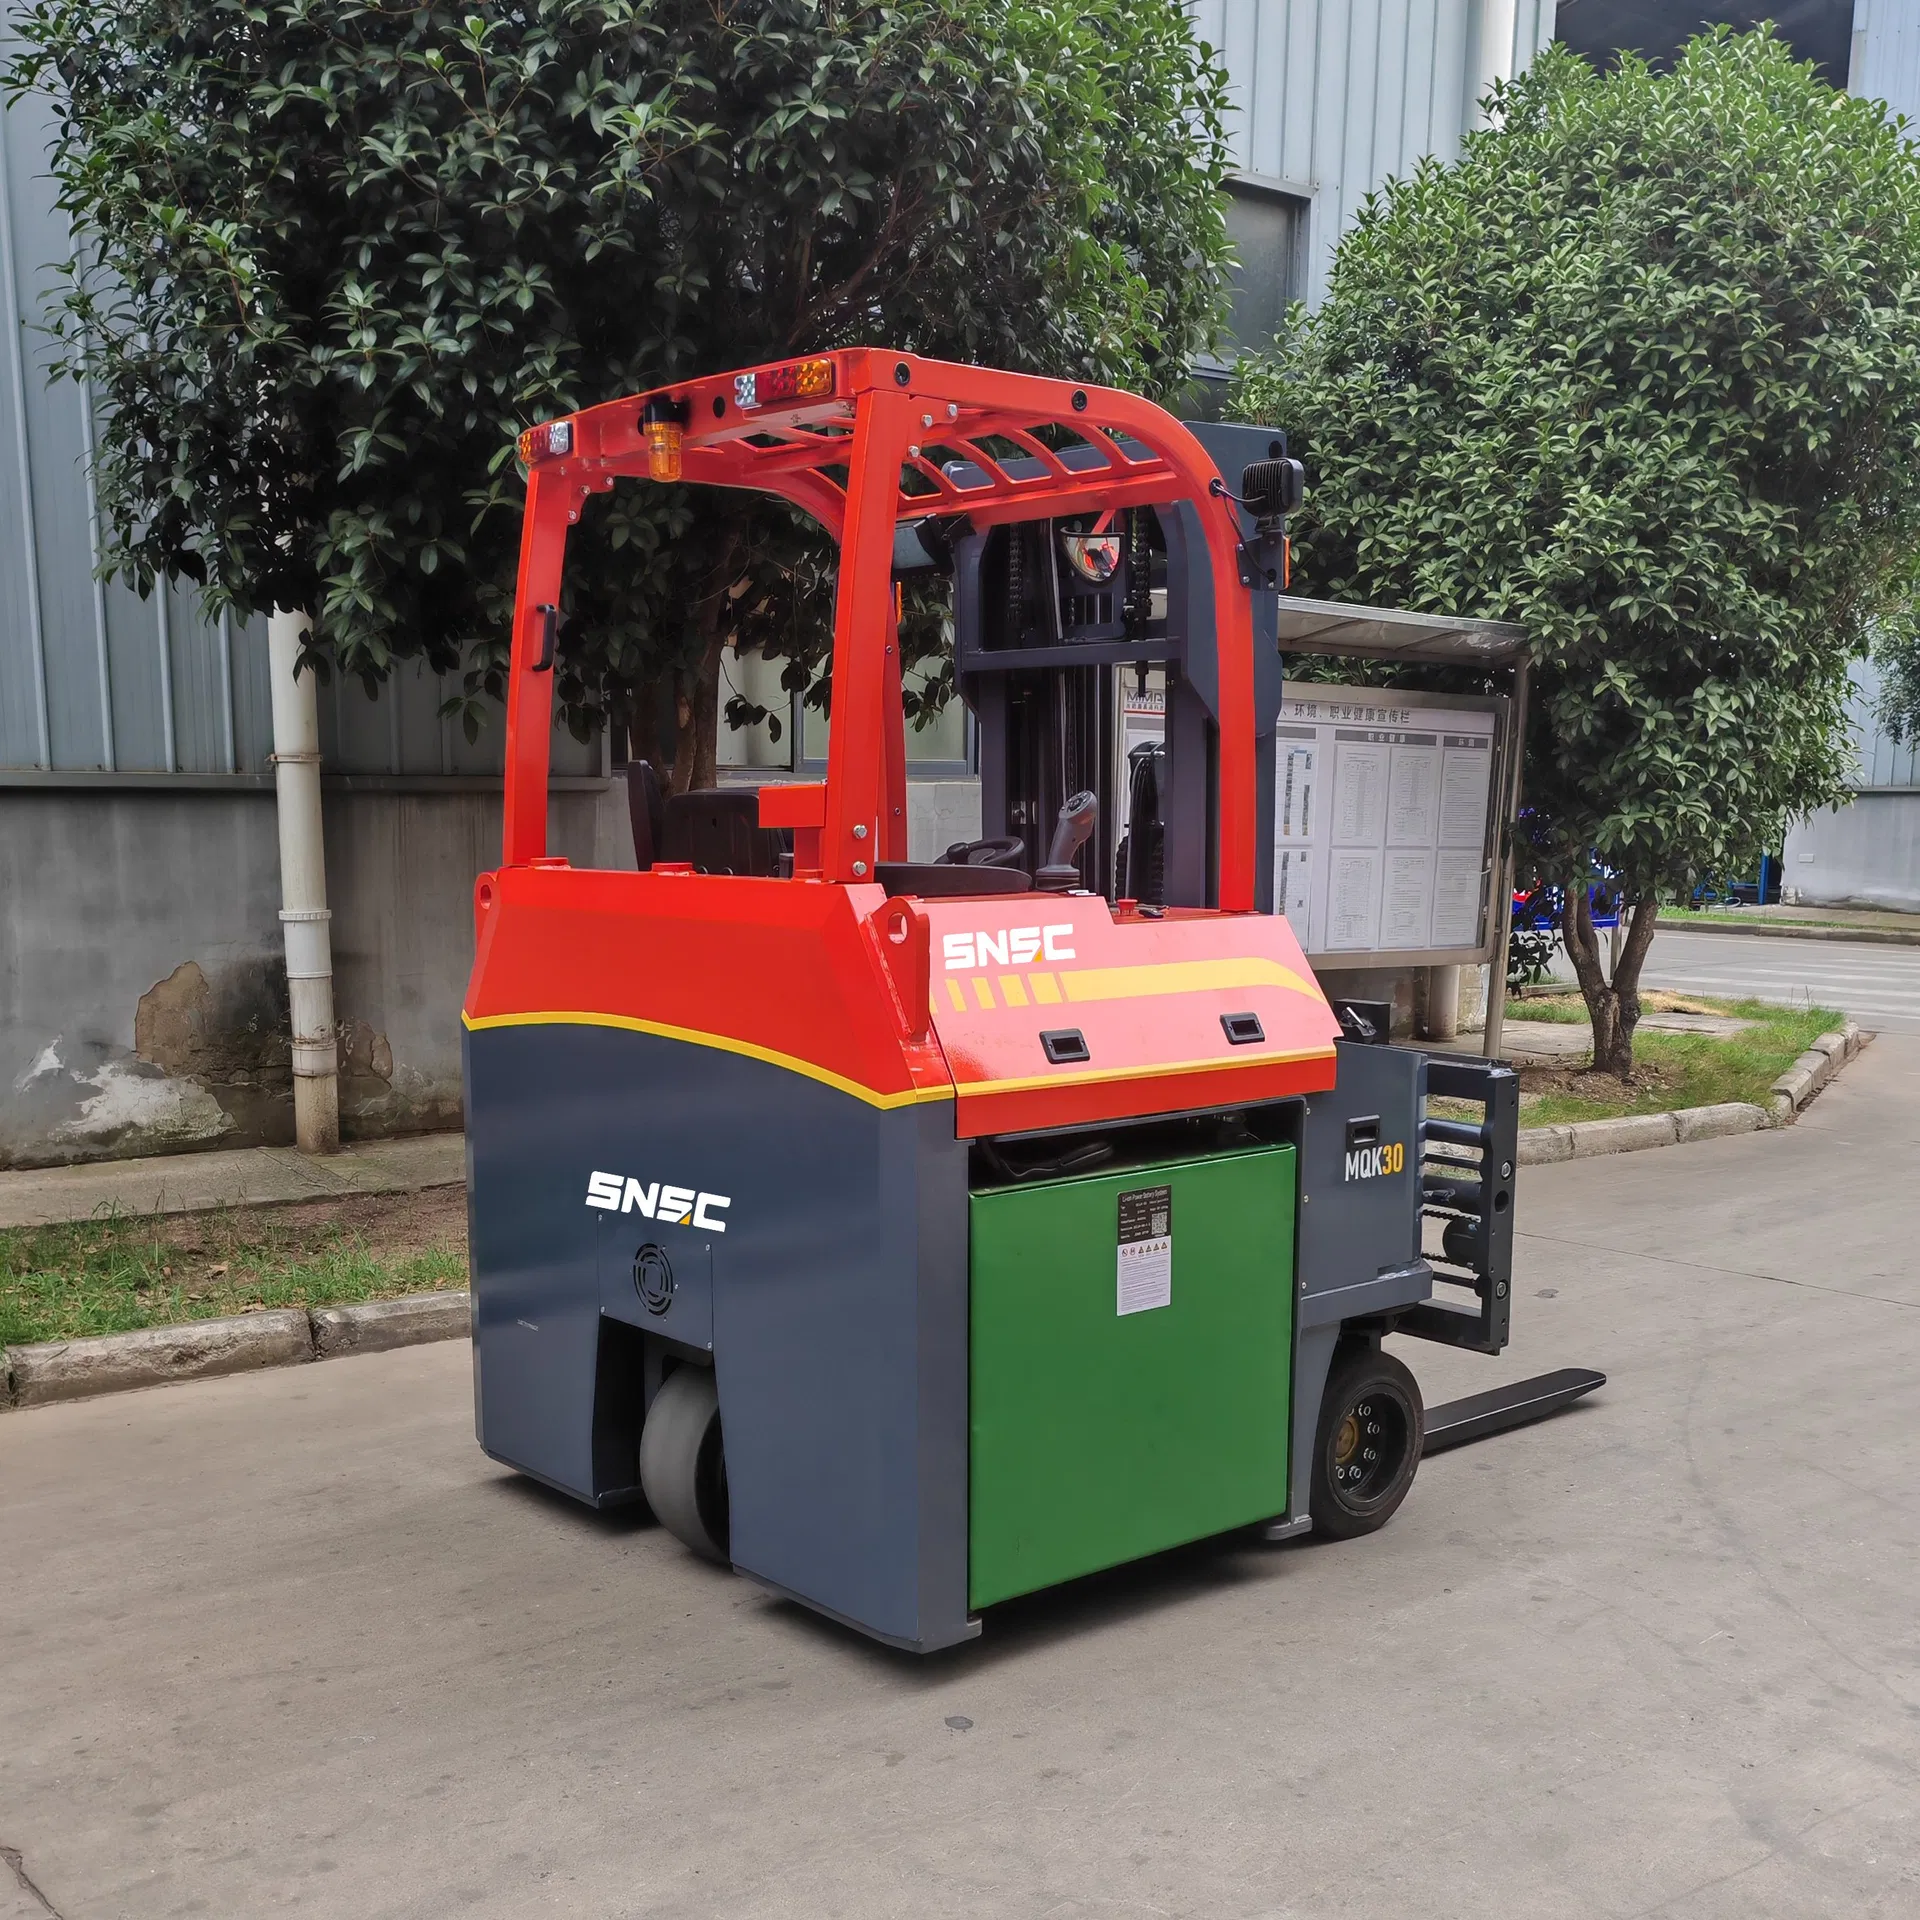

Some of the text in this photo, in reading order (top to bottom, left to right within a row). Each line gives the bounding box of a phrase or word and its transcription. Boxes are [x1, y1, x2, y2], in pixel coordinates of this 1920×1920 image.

[943, 923, 1076, 970] SNSC
[1345, 1142, 1404, 1182] MQK30
[585, 1170, 731, 1232] SNSC
